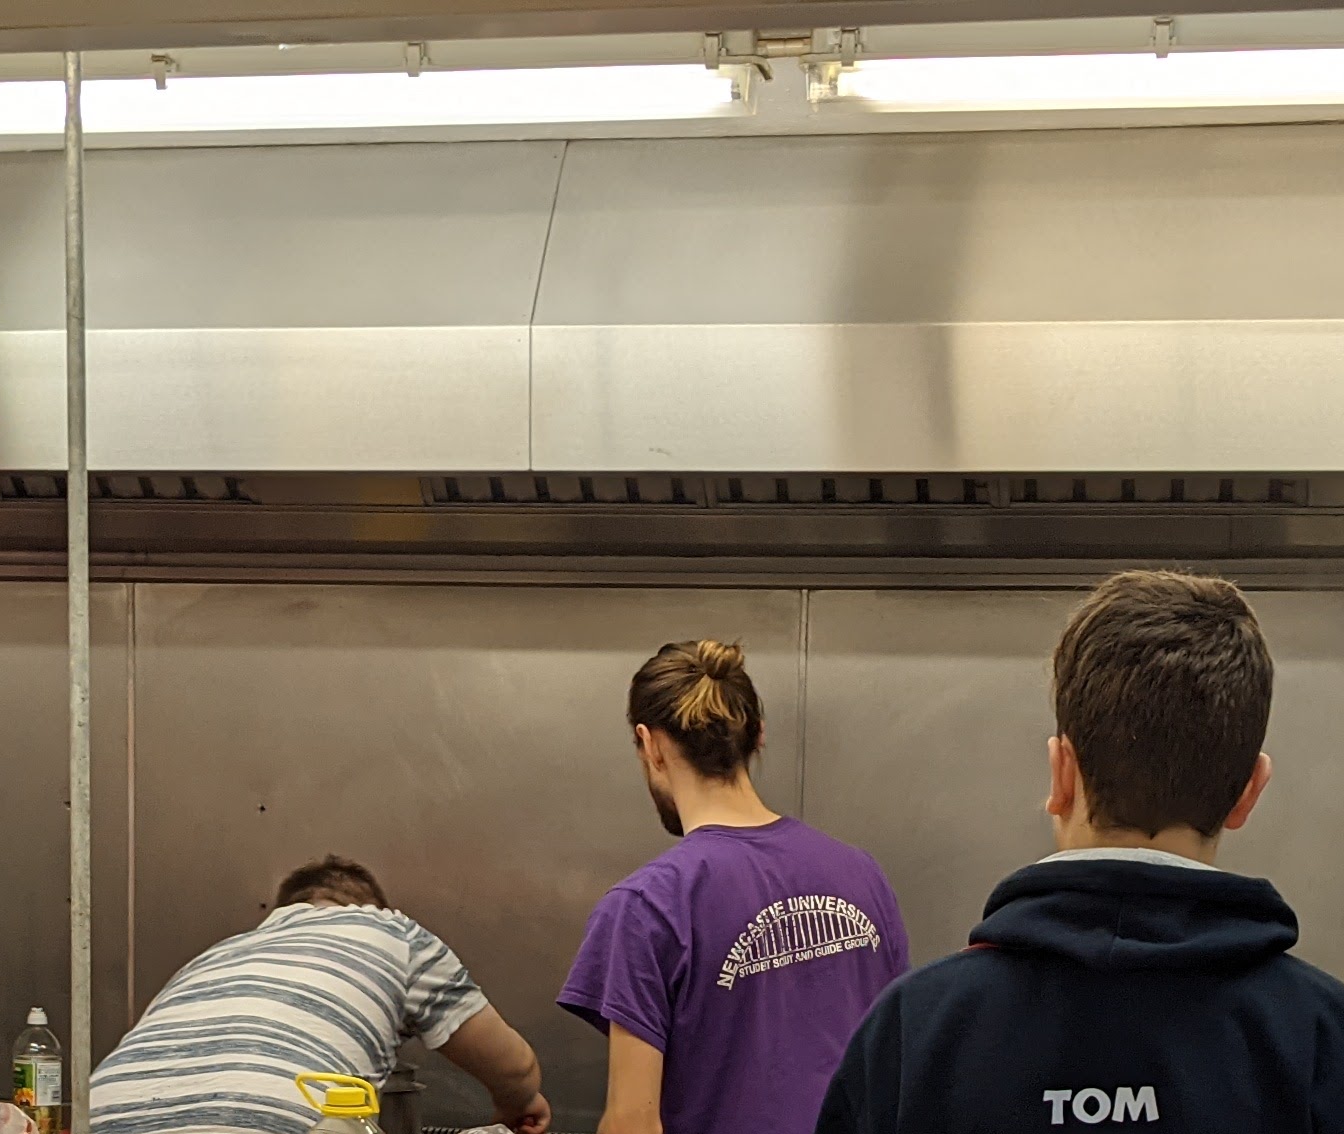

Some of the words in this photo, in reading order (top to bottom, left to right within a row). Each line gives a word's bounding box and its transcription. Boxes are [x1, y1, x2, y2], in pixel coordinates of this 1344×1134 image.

[815, 943, 843, 958] GUIDE
[844, 936, 869, 951] GROUP
[1042, 1085, 1160, 1125] TOM
